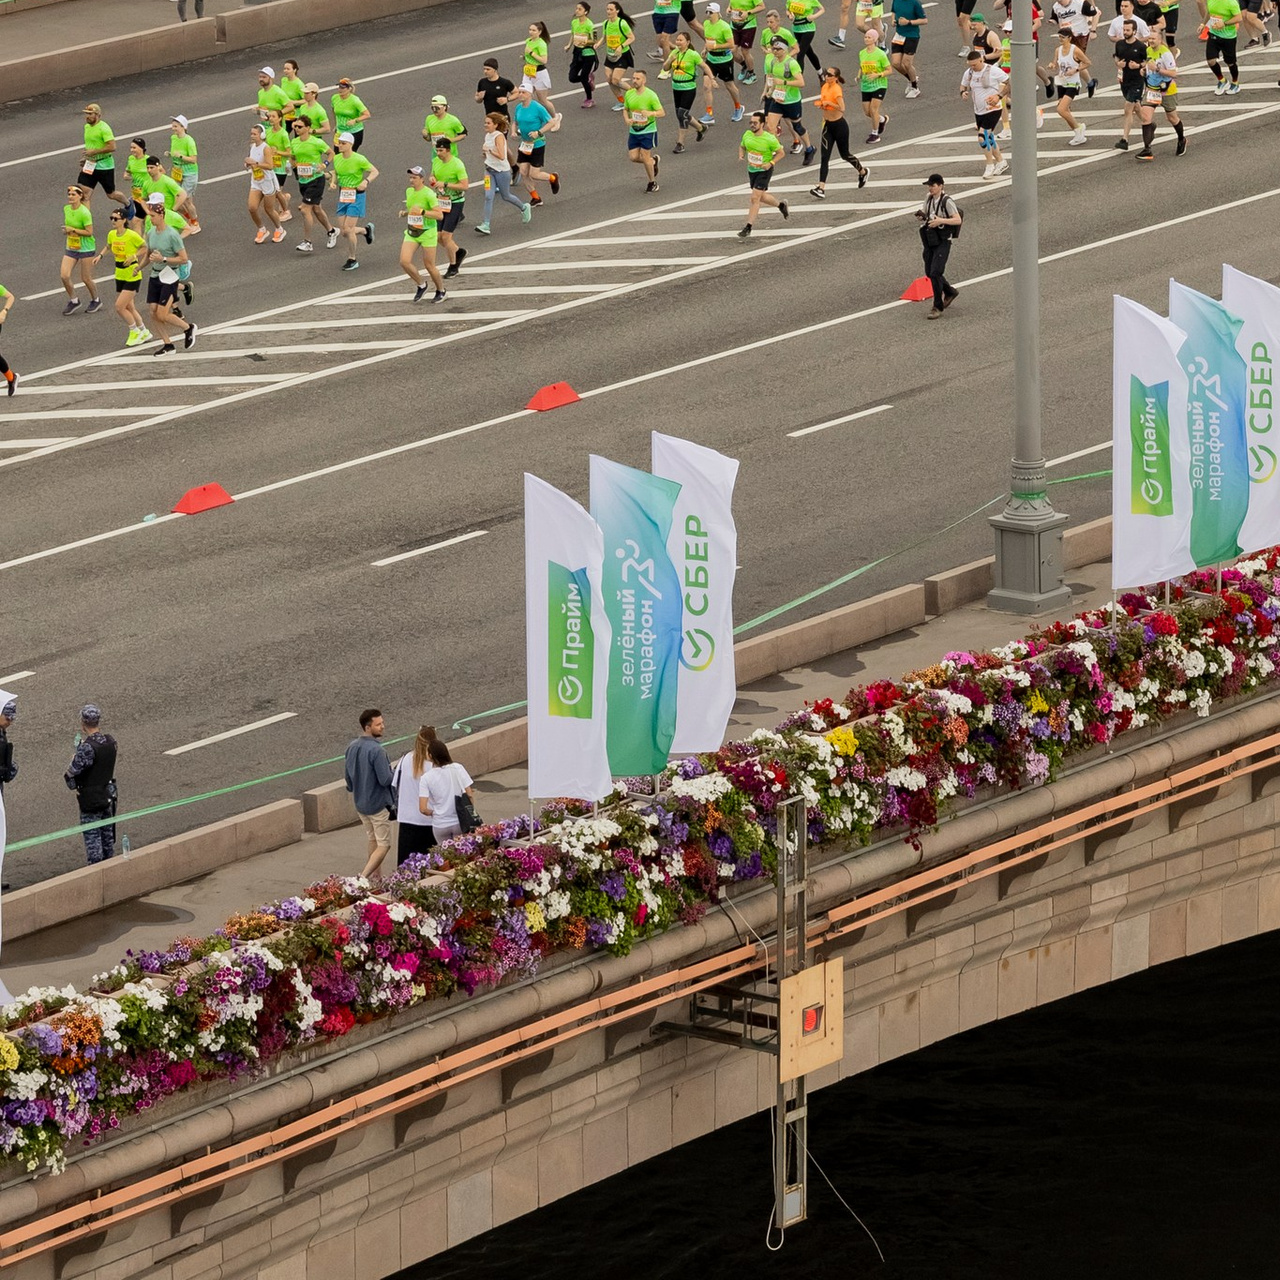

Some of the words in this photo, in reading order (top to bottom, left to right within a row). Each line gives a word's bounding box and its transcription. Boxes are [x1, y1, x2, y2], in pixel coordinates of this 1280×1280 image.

[1249, 341, 1272, 434] СБЕР
[1140, 397, 1161, 474] Прайм
[1206, 411, 1225, 501] марафон
[684, 513, 709, 617] СБЕР
[561, 582, 582, 670] Прайм
[615, 588, 636, 687] зелёный
[640, 599, 658, 700] марафон
